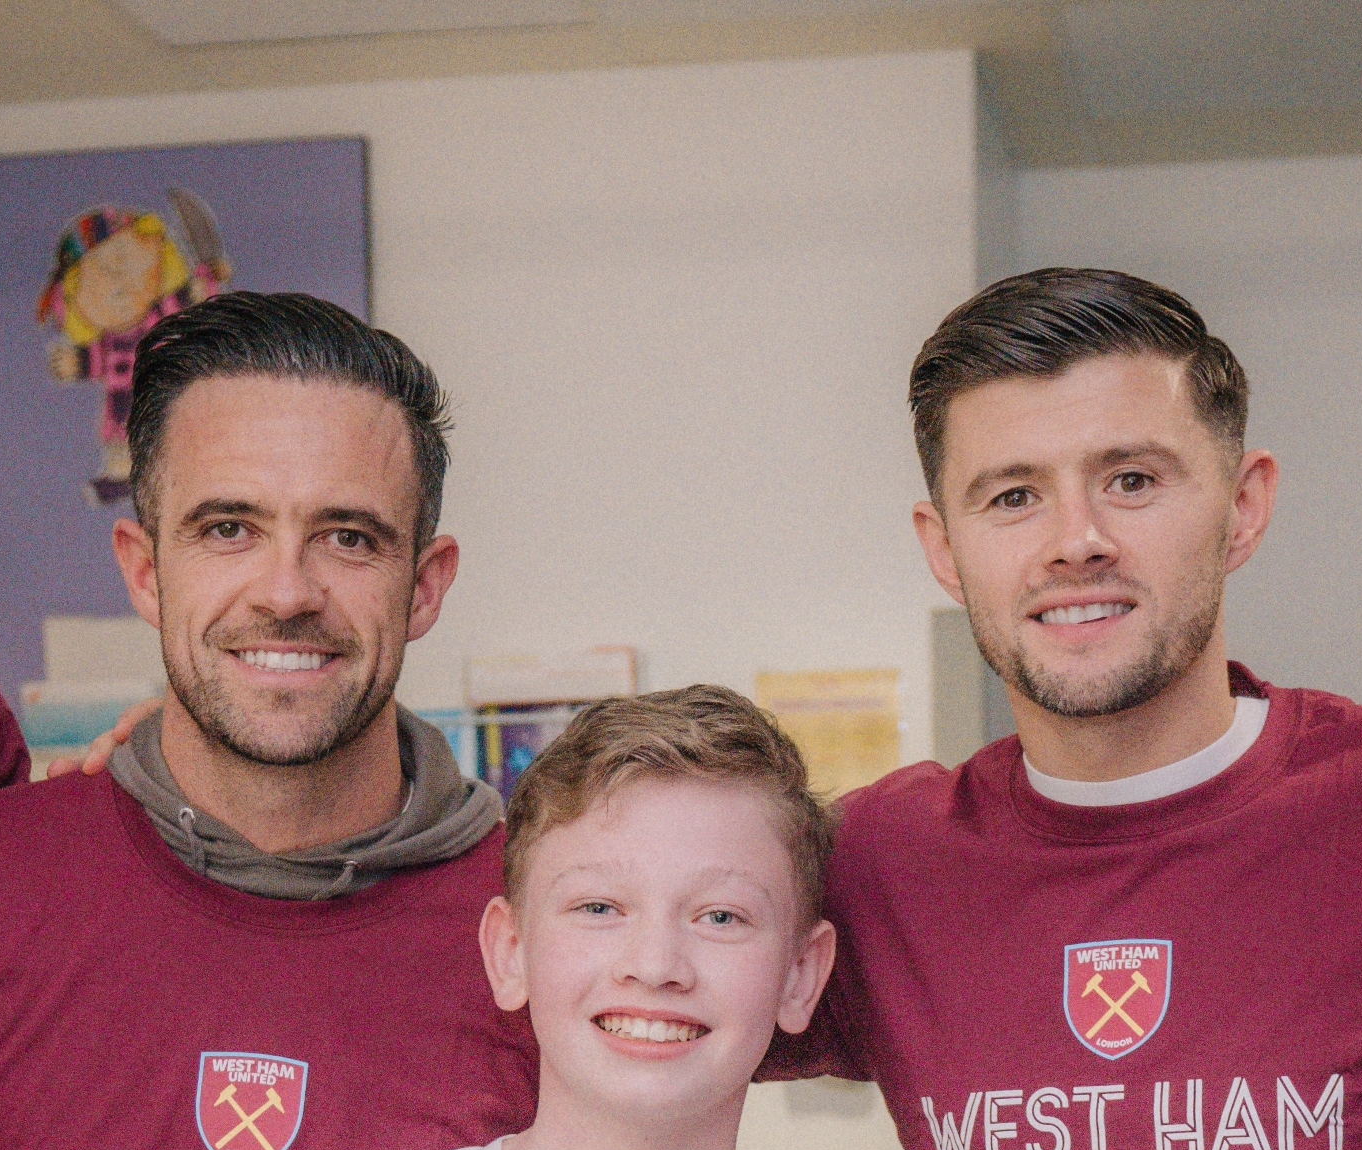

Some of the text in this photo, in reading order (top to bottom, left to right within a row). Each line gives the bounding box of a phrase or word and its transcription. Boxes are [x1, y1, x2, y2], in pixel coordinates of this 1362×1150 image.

[1076, 946, 1160, 964] WEST HAM
[1093, 959, 1142, 972] UNITED
[1095, 1036, 1133, 1049] LONDON
[212, 1058, 295, 1080] WEST HAM
[228, 1072, 277, 1086] UNITED
